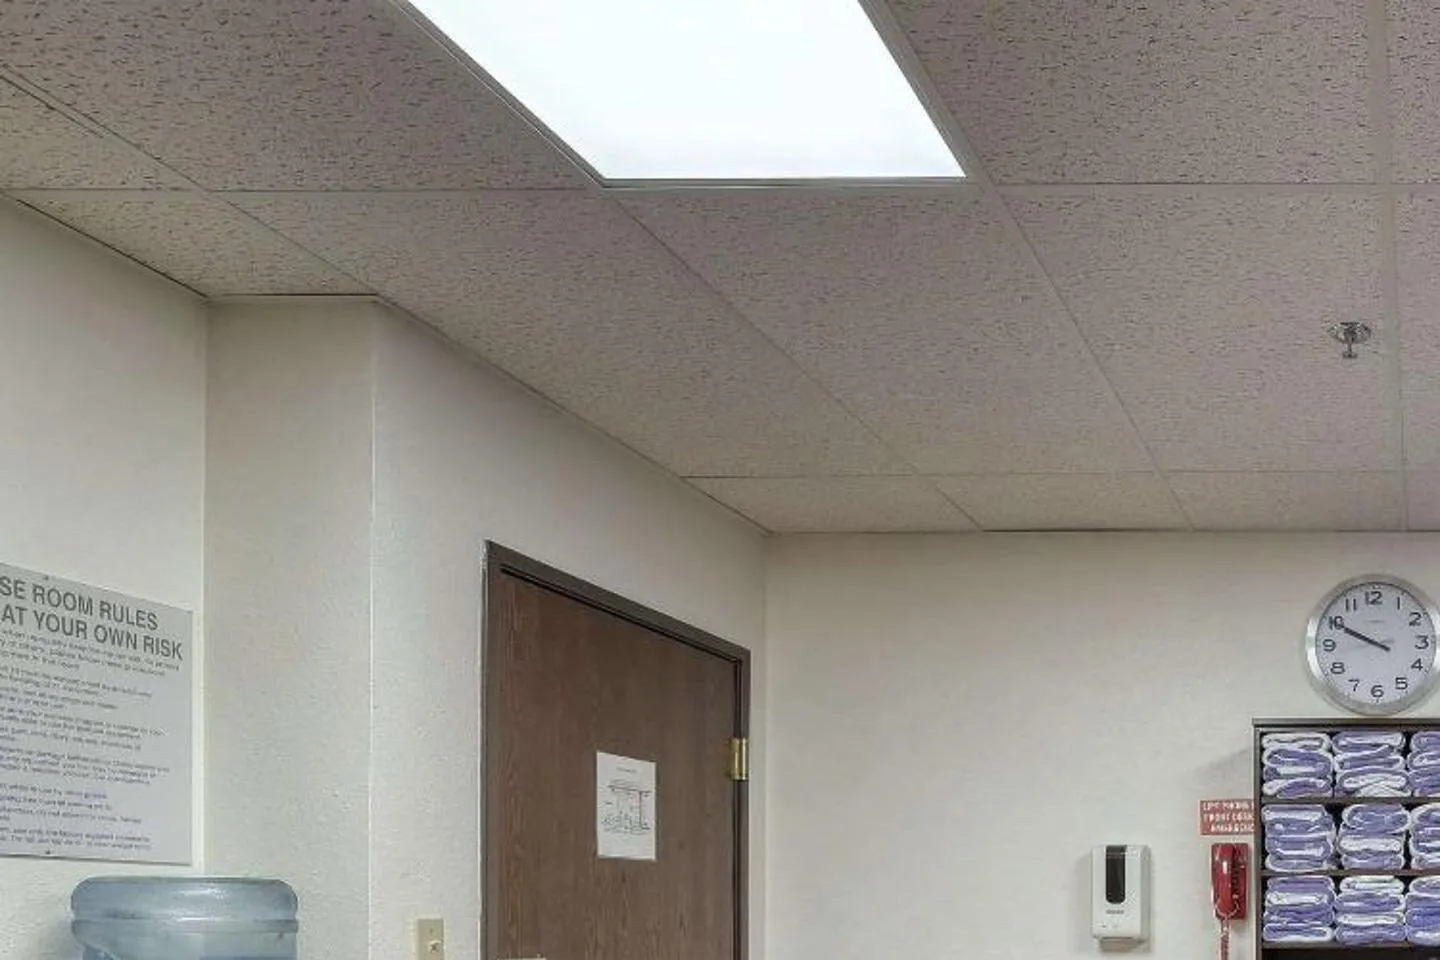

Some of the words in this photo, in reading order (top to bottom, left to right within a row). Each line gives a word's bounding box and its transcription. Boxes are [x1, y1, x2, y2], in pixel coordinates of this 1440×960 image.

[1345, 598, 1357, 612] 11
[1365, 590, 1383, 606] 12
[32, 583, 93, 616] ROOM
[99, 600, 158, 631] RULES
[1328, 615, 1344, 630] 10
[1408, 612, 1422, 627] 2
[1, 604, 28, 626] AT
[33, 609, 88, 640] YOUR
[94, 624, 138, 650] OWN
[143, 635, 183, 661] RISK
[1322, 638, 1336, 652] 9
[1414, 635, 1429, 650] 3
[1330, 662, 1345, 675] 8
[1410, 658, 1423, 671] 4
[1348, 679, 1360, 692] 7
[1395, 677, 1409, 690] 5
[1370, 684, 1384, 699] 6
